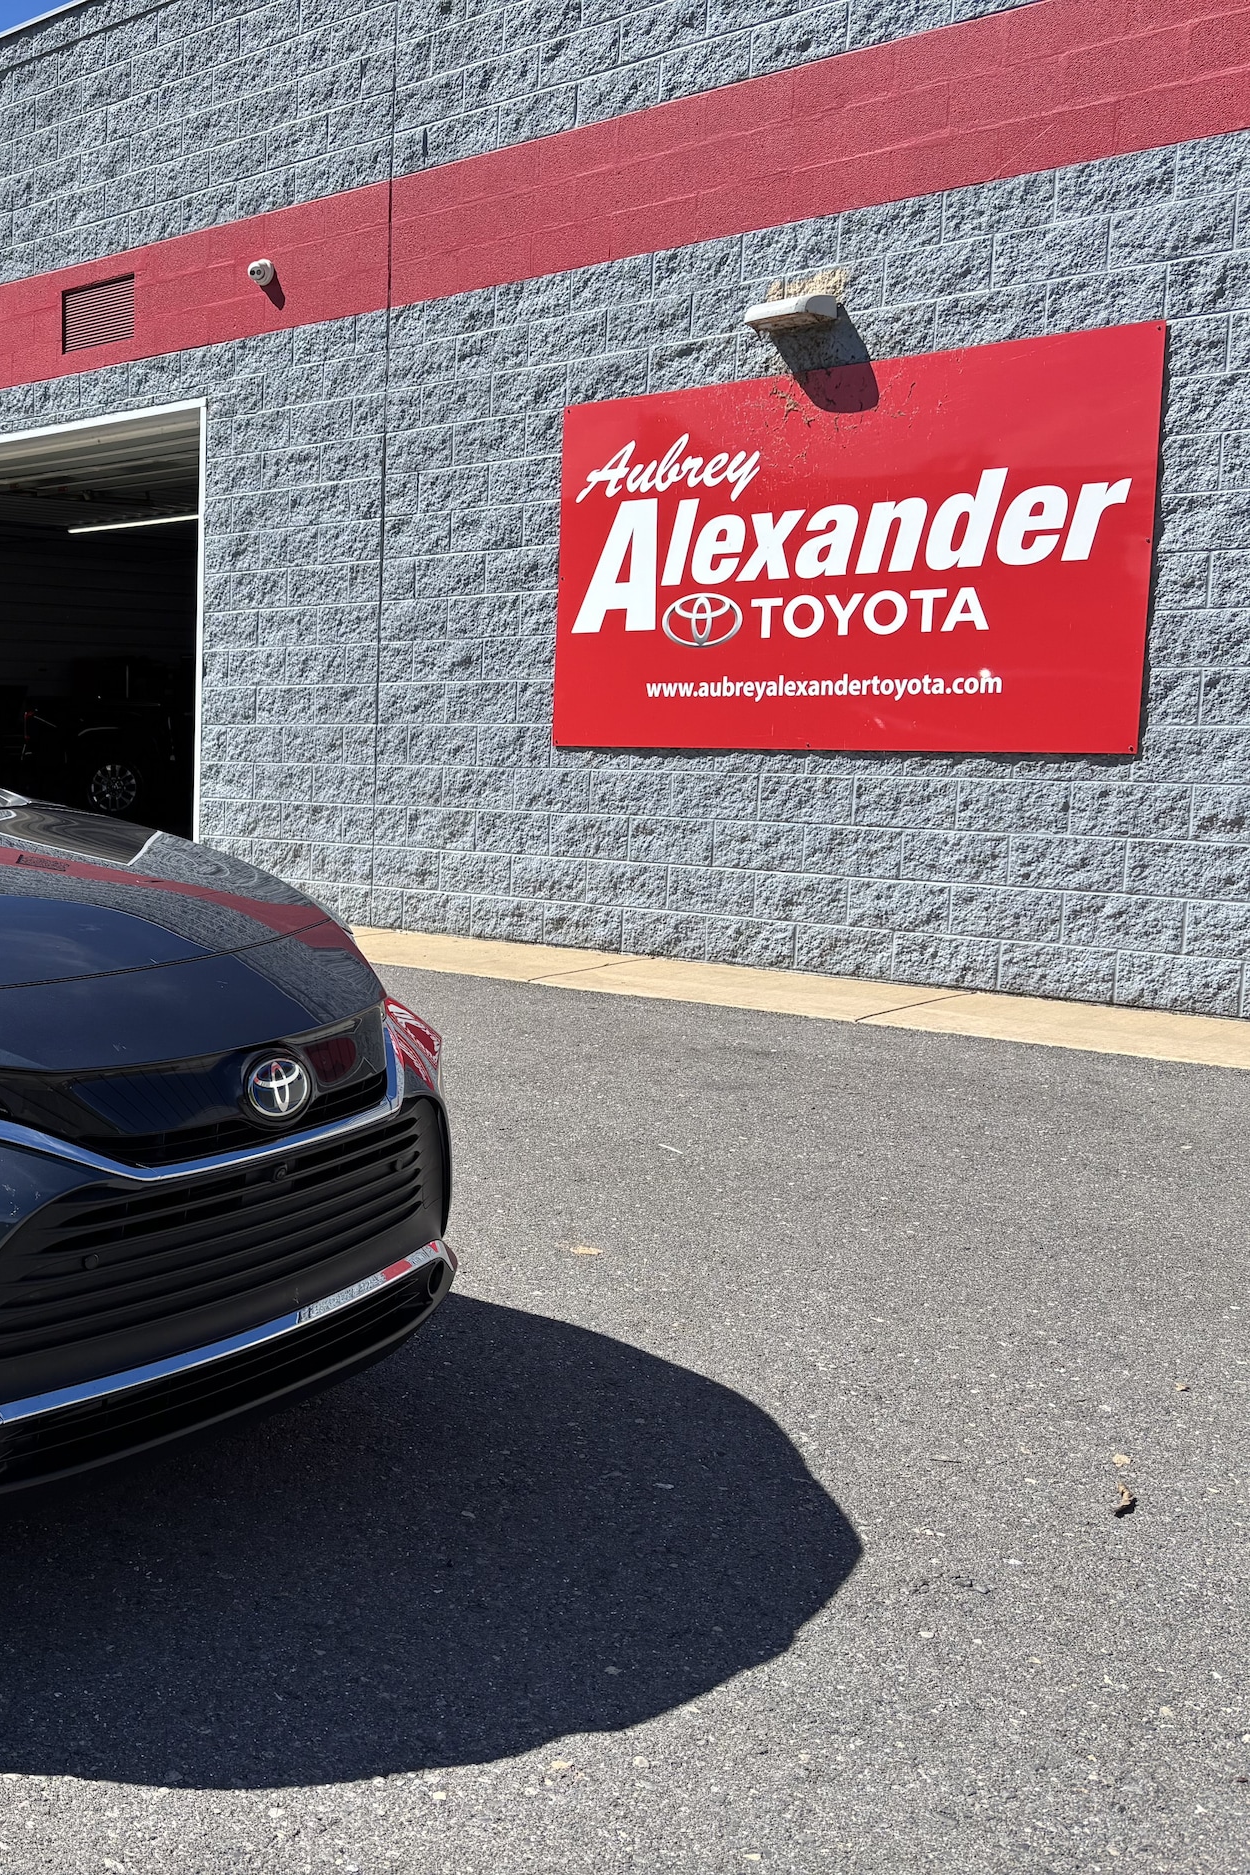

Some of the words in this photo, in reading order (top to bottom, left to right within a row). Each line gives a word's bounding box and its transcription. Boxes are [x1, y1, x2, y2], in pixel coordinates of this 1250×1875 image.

[576, 433, 760, 503] Aubrey
[572, 467, 1133, 634] Alexander
[751, 587, 990, 638] TOYOTA
[646, 673, 1003, 702] www.aubreyalexandertoyota.com
